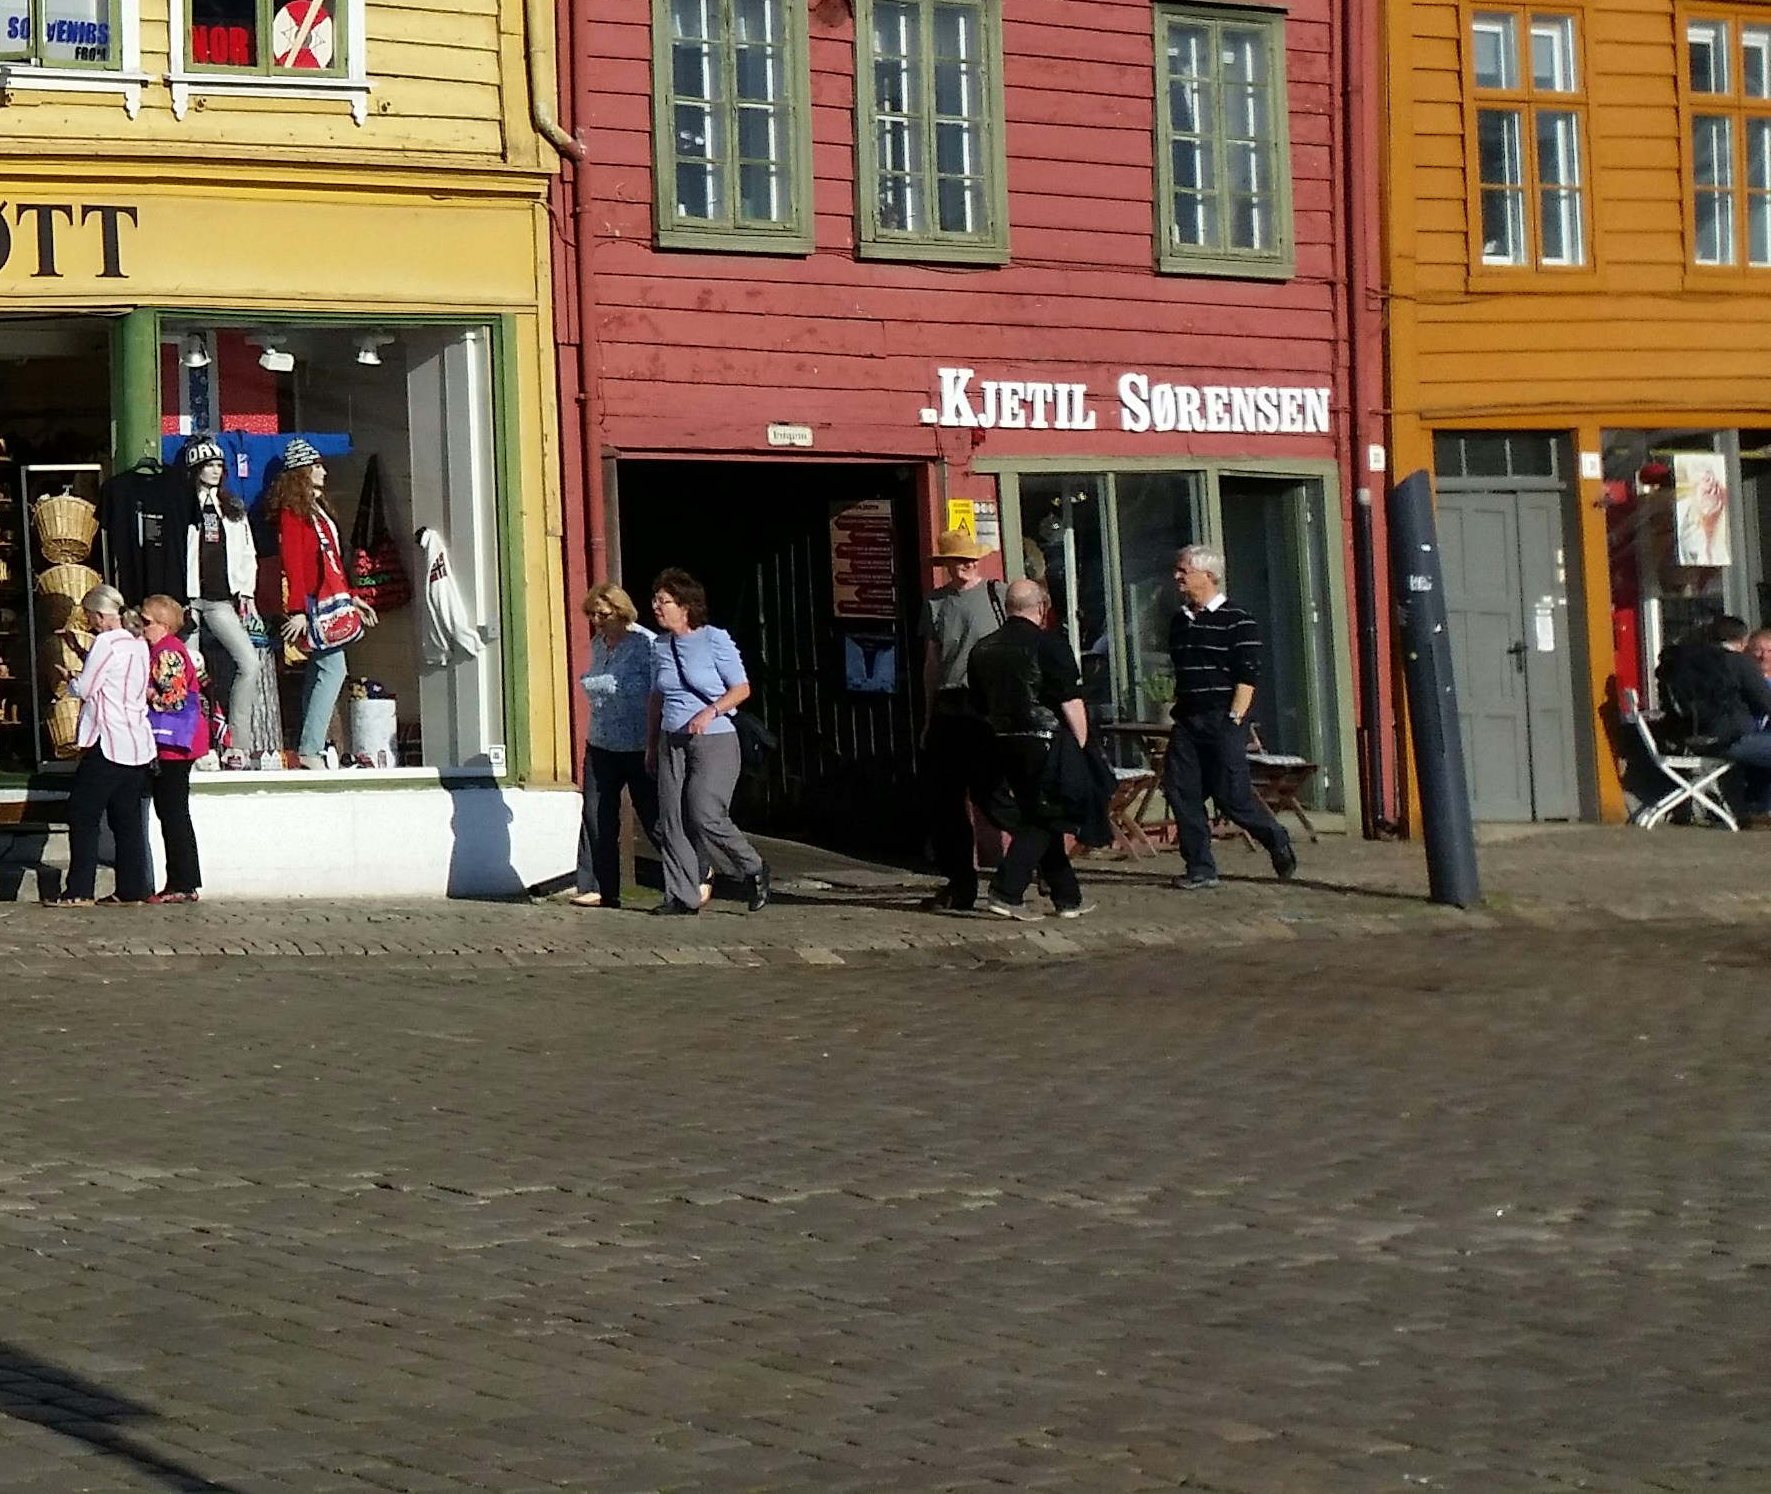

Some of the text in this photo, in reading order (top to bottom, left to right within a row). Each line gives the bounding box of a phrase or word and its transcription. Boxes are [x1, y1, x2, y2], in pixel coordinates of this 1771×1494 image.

[6, 15, 110, 45] SOVENIRS
[192, 25, 249, 65] NOR
[937, 367, 1331, 433] KJETIL SØRENSEN
